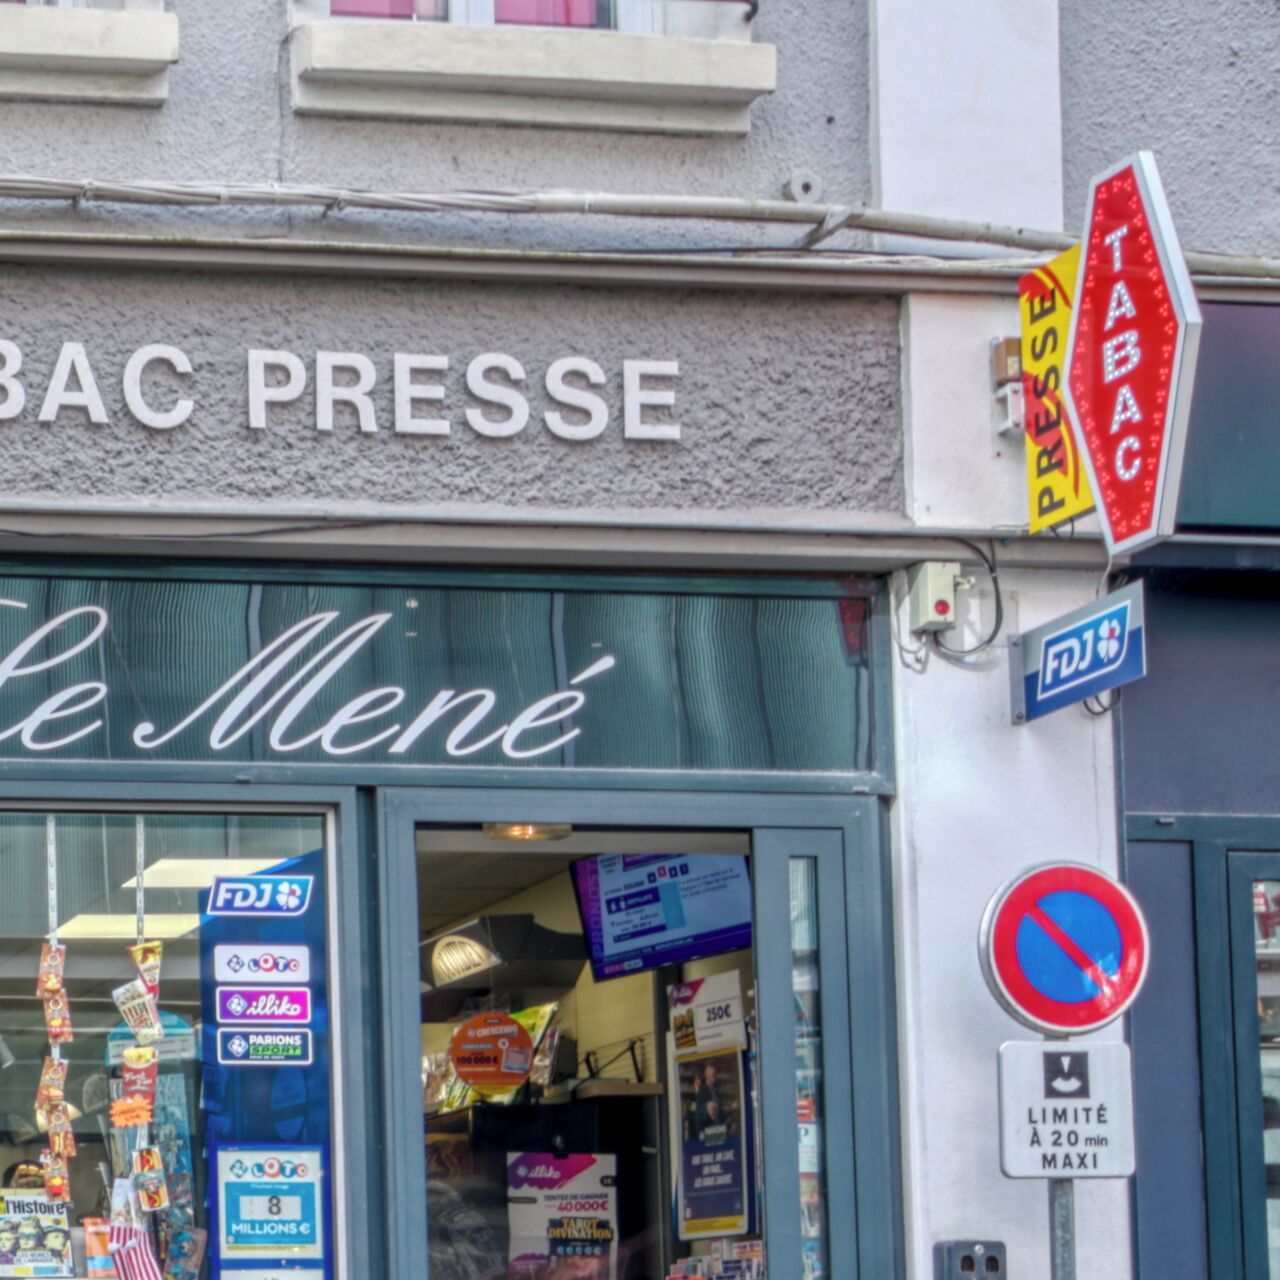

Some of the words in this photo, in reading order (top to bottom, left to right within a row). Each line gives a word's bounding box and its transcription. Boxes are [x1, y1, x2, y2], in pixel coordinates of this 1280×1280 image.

[1104, 225, 1141, 482] TABAC
[248, 349, 683, 442] PRESSE
[1029, 287, 1066, 518] PRESSE
[1044, 628, 1095, 686] FDJ
[134, 611, 617, 759] Mené
[215, 882, 273, 909] FDJ
[247, 953, 300, 973] LOTO
[246, 993, 302, 1016] illiko
[706, 1003, 732, 1023] 250€
[249, 1034, 302, 1045] PARIONS
[250, 1046, 302, 1056] SPORT
[1028, 1103, 1108, 1124] LIMITÉ
[1030, 1126, 1041, 1147] À
[1051, 1130, 1079, 1147] 20
[1084, 1134, 1108, 1147] min
[251, 1157, 309, 1178] LOTO
[1042, 1153, 1098, 1170] MAXI
[268, 1195, 282, 1216] 8
[231, 1223, 297, 1234] MILLIONS
[299, 1223, 310, 1234] €
